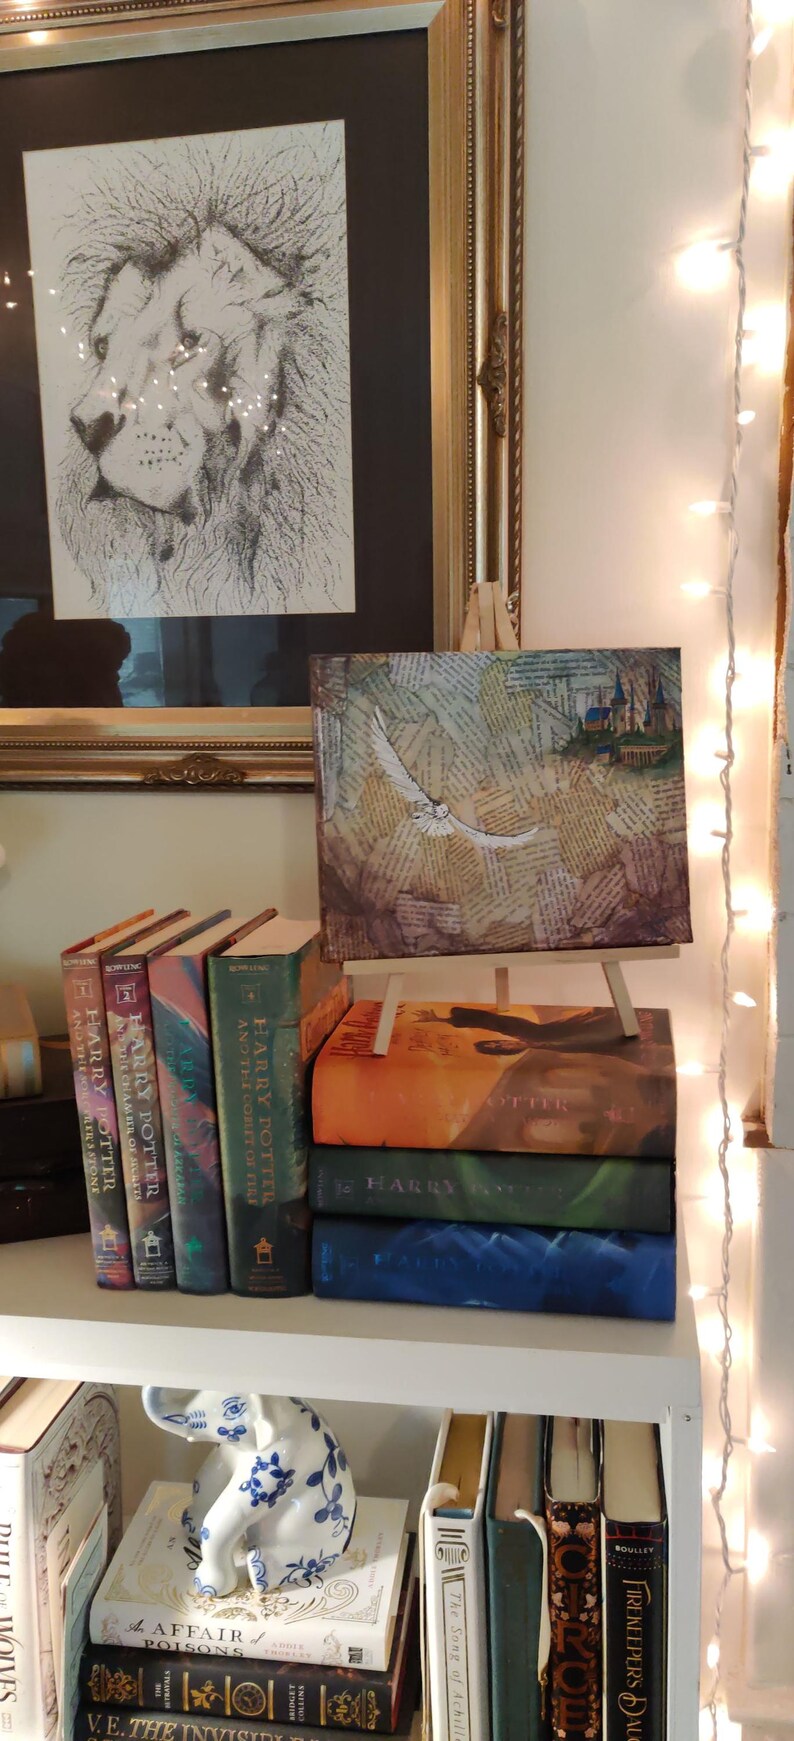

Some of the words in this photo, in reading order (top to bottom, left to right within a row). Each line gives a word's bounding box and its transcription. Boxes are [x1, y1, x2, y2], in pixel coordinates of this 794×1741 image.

[63, 958, 97, 966] ROWLING
[105, 963, 142, 972] ROWLING
[228, 964, 270, 973] ROWLING
[123, 991, 130, 1000] 2
[73, 1010, 84, 1041] AND
[238, 1019, 249, 1055] AND
[77, 1044, 87, 1072] THE
[86, 1008, 108, 1098] HARRY
[120, 1046, 129, 1070] THE
[129, 1012, 152, 1100] HARRY
[254, 1016, 273, 1109] HARRY
[240, 1058, 251, 1089] THE
[122, 1074, 135, 1135] CHAMBER
[96, 1107, 116, 1193] POTTER
[129, 1138, 138, 1154] OF
[140, 1110, 160, 1199] POTTER
[89, 1152, 100, 1194] STONE
[259, 1117, 275, 1206] POTTER
[131, 1157, 143, 1200] SECRETS
[366, 1176, 457, 1194] HARRY
[615, 1545, 655, 1554] BOULLEY
[450, 1593, 462, 1618] The
[125, 1618, 145, 1634] An
[152, 1622, 244, 1643] AFFAIR
[250, 1631, 266, 1645] of
[450, 1626, 462, 1661] Song
[554, 1544, 595, 1731] CIRCE
[143, 1639, 244, 1657] POISONS
[264, 1649, 312, 1659] THORLEY
[271, 1641, 305, 1650] ADDIE
[0, 1616, 22, 1704] WOLVES
[451, 1670, 463, 1686] of
[87, 1713, 101, 1733] V.
[106, 1716, 125, 1737] E.
[128, 1718, 177, 1741] THE
